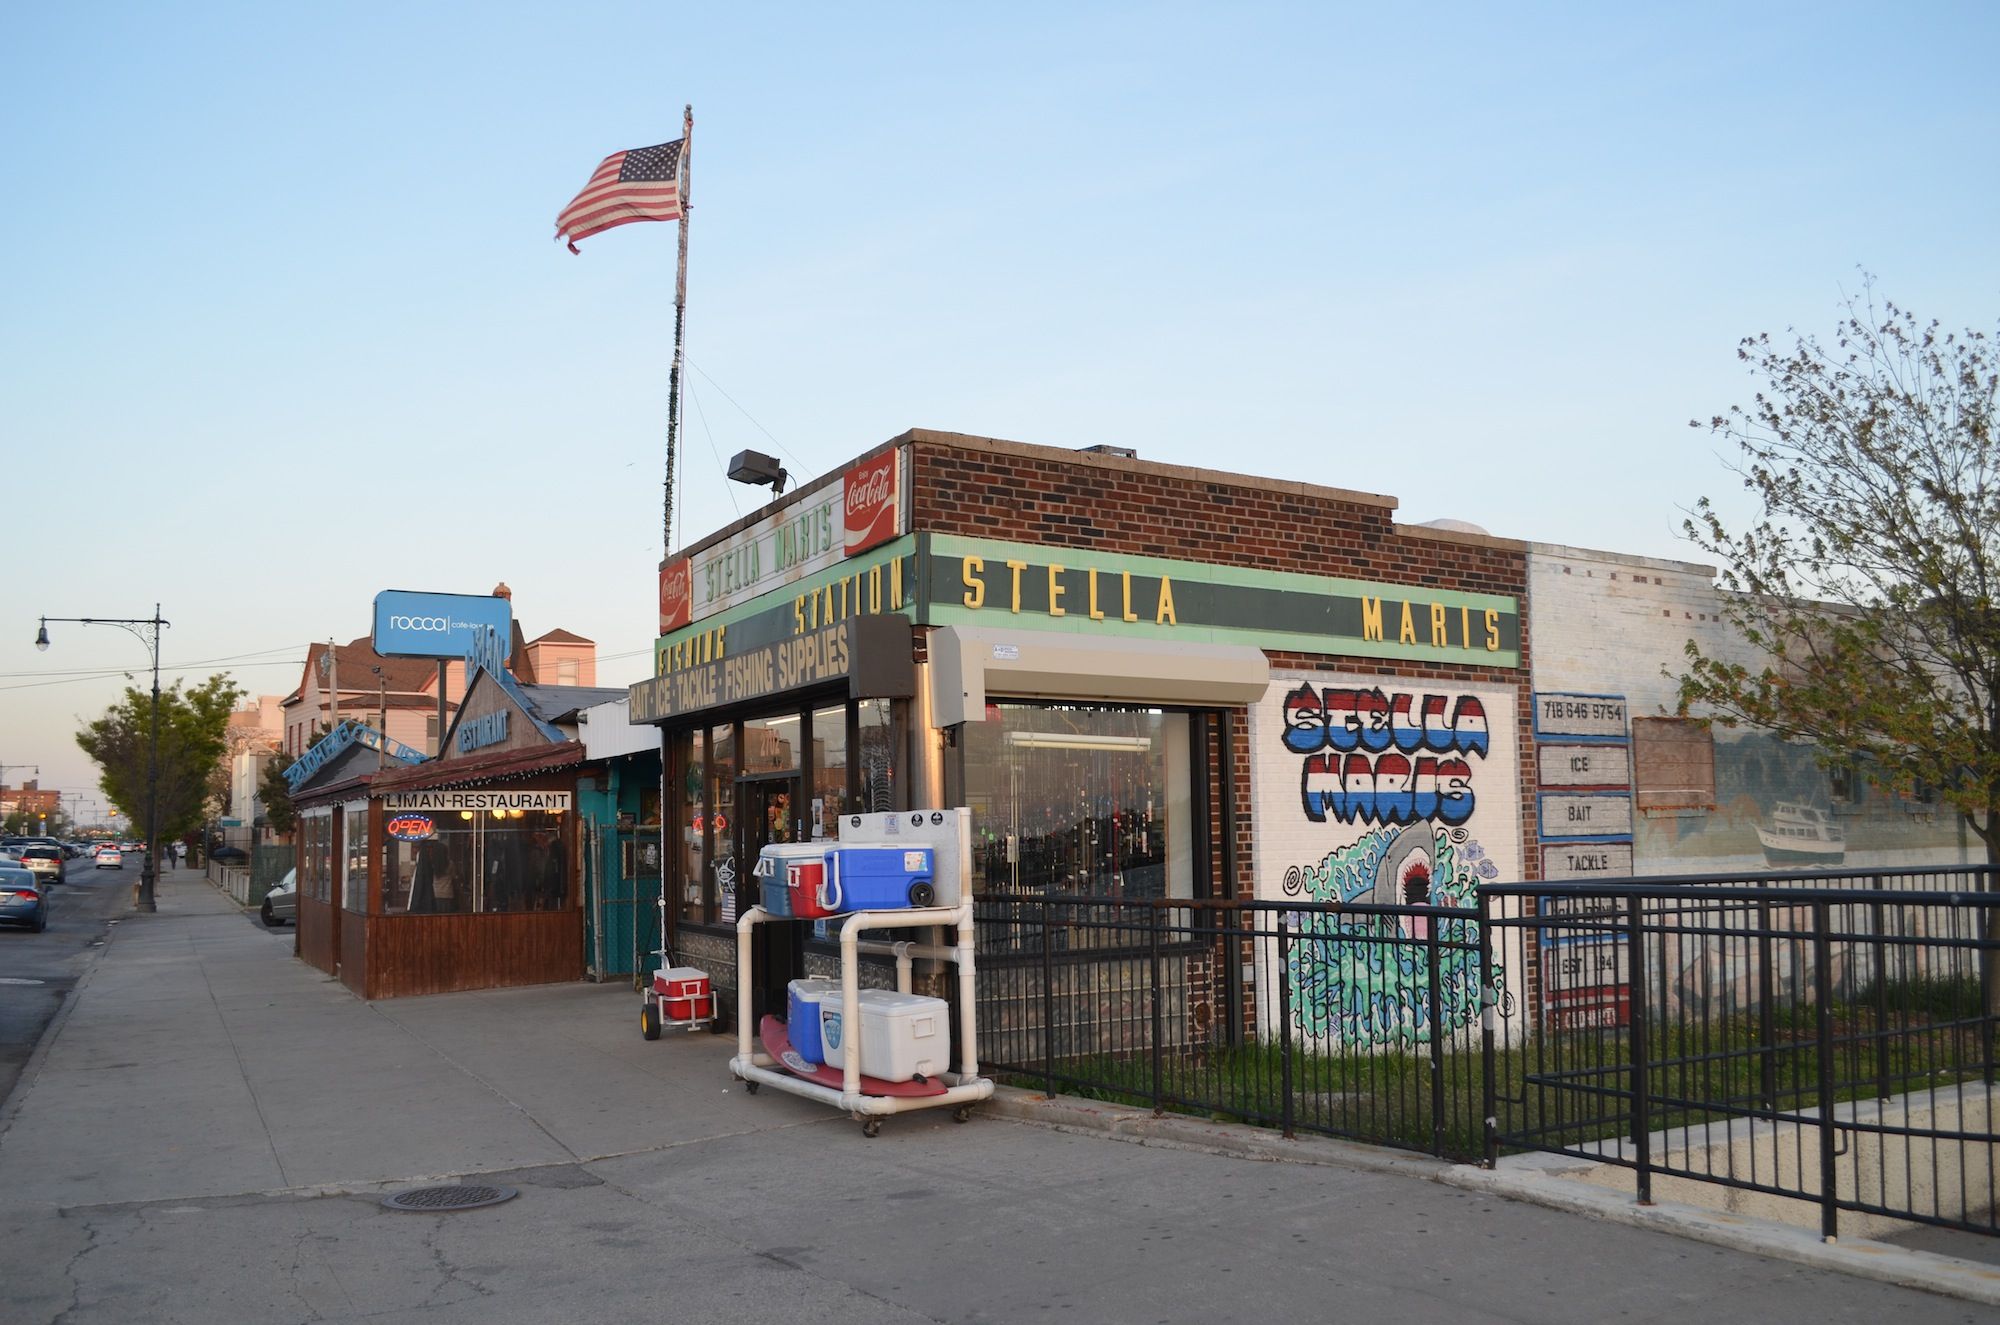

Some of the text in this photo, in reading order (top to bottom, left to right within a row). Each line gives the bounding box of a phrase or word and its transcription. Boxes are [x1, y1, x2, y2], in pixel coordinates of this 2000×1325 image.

[705, 501, 832, 603] STELLA MARIS
[390, 615, 447, 632] rocca
[657, 555, 904, 678] FISHING STATION
[962, 554, 1502, 653] STELLA MARIS
[630, 623, 850, 721] BAIT ICE TACKLE FISHING SUPPLIES
[1281, 680, 1490, 761] STELLA
[1544, 702, 1622, 720] 718 646 9754
[1570, 757, 1589, 773] ICE
[1301, 752, 1476, 827] MARIS
[387, 820, 433, 835] OPEN
[1568, 806, 1592, 822] BAIT
[1567, 855, 1609, 872] TACKLE
